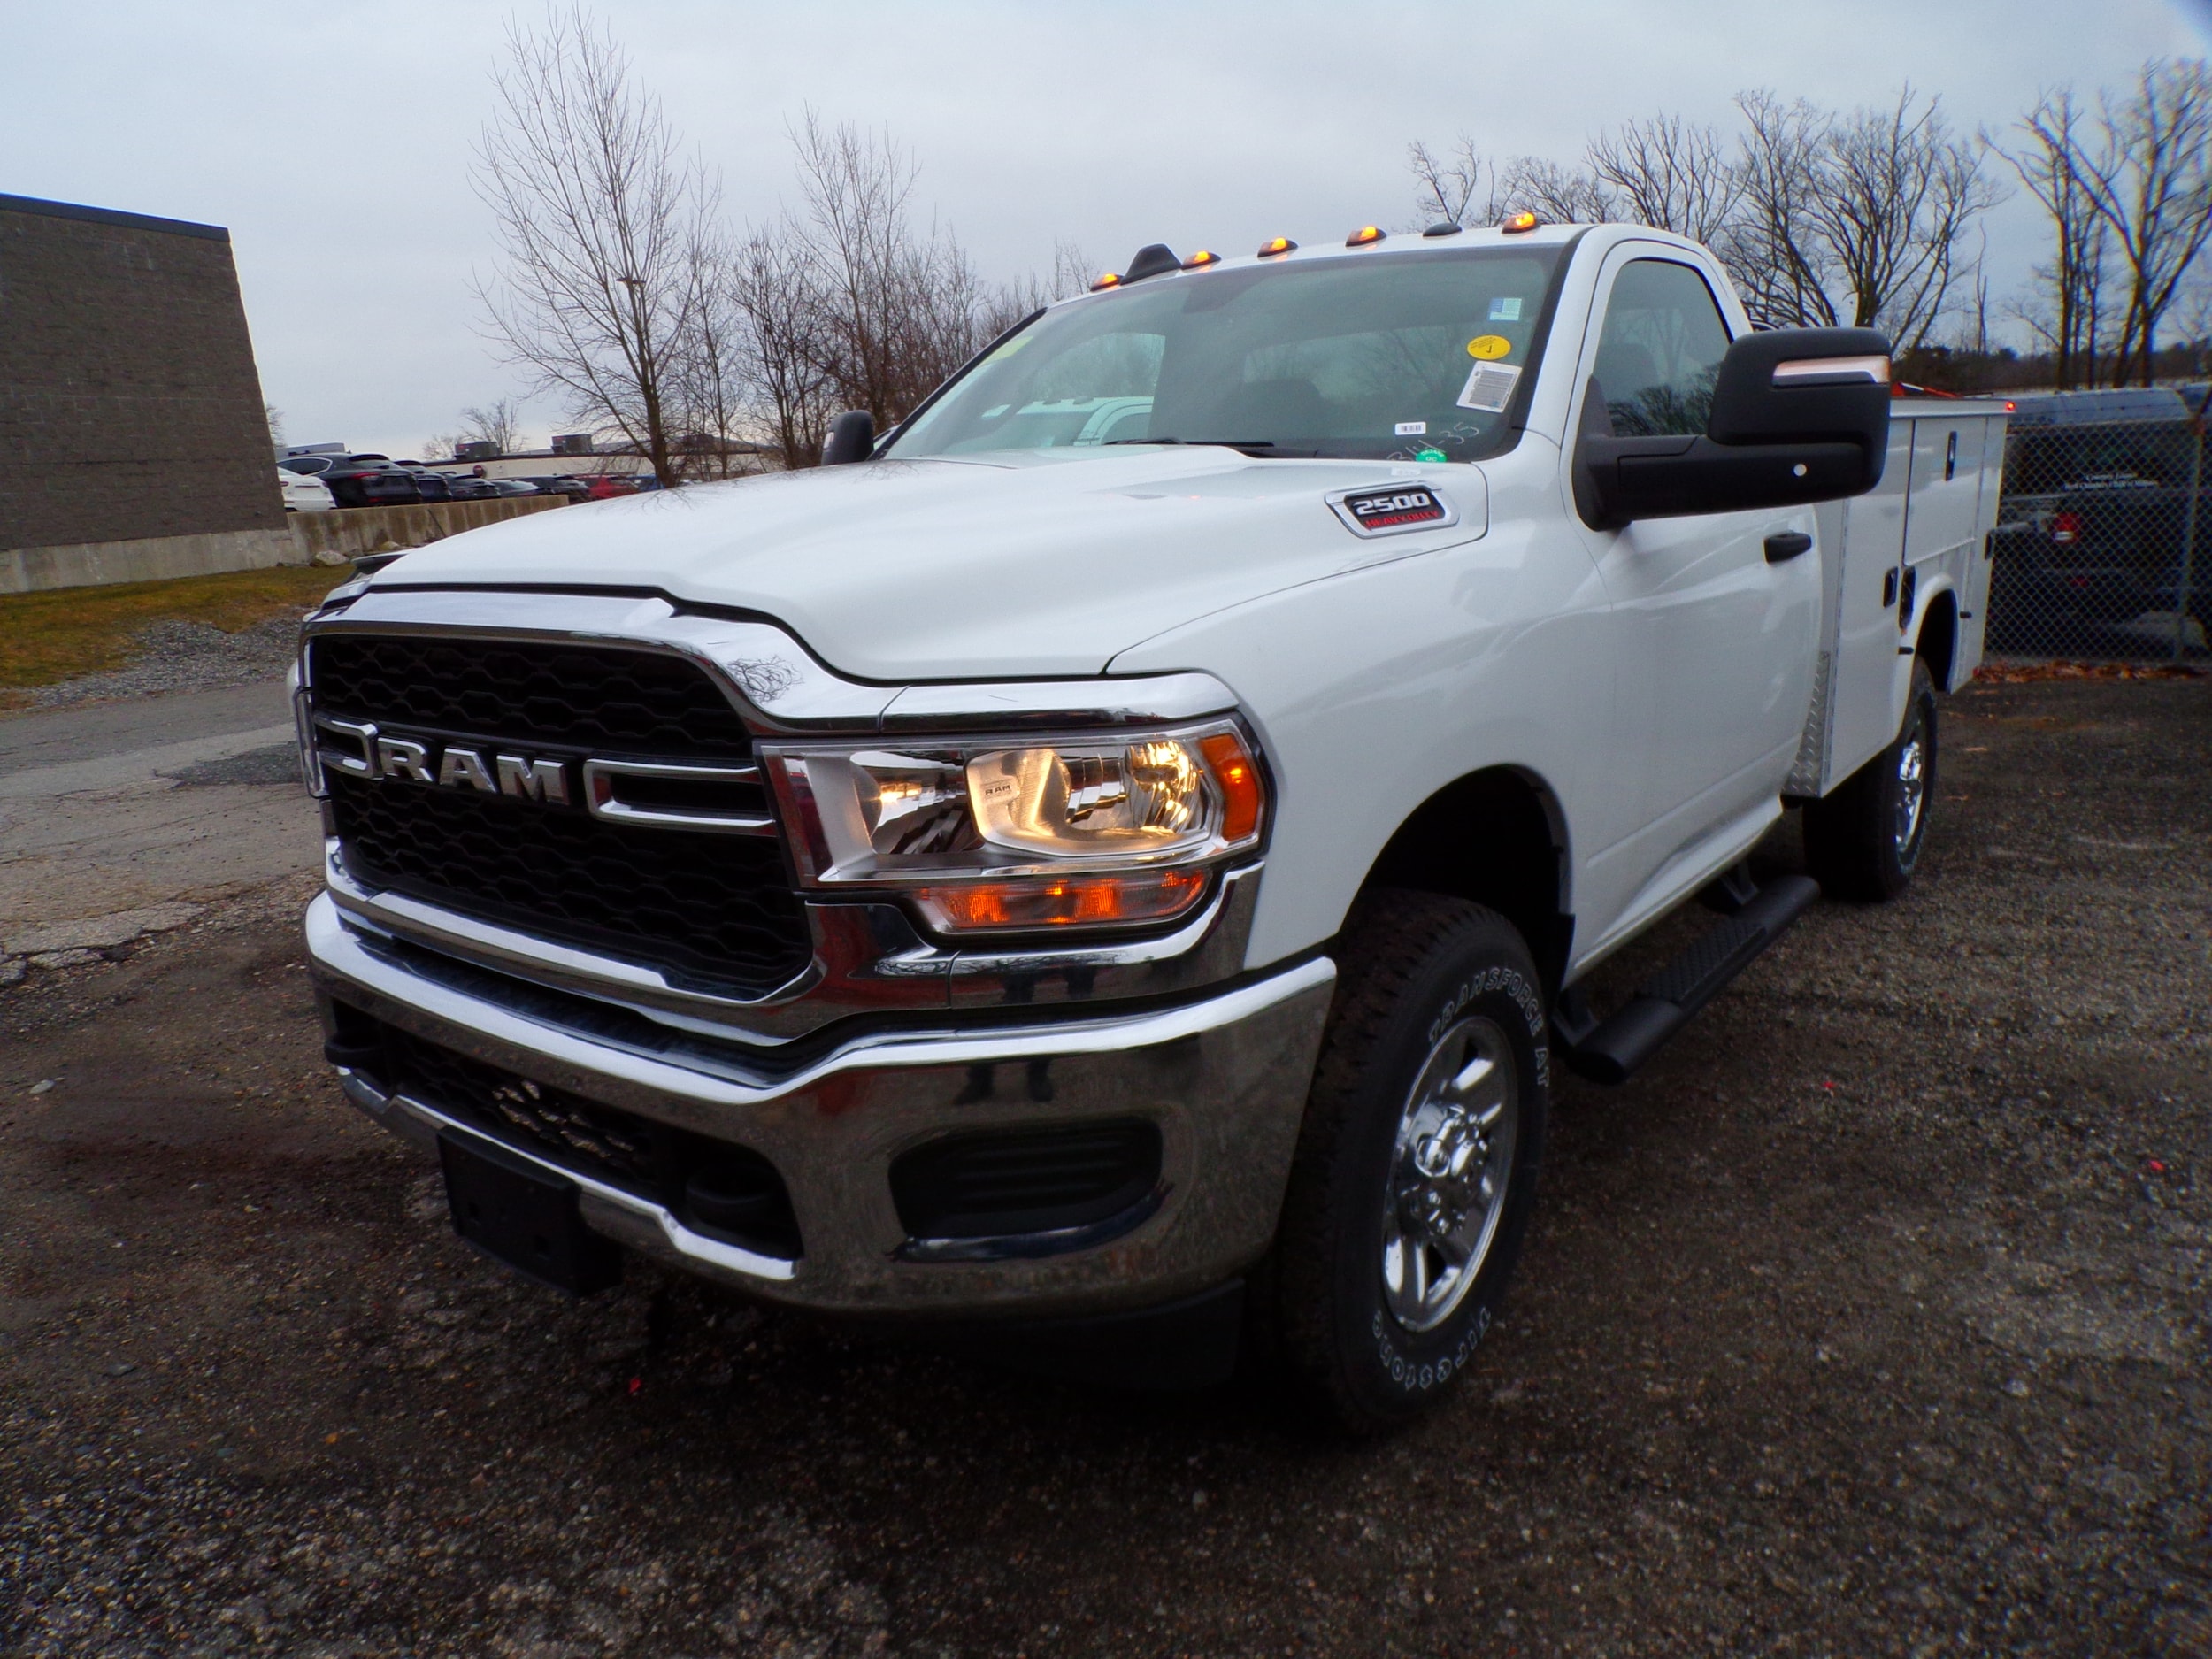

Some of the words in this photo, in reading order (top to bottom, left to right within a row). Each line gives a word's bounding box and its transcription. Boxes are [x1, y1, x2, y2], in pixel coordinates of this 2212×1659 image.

[1353, 493, 1431, 515] 2500
[377, 737, 570, 805] RAM
[985, 785, 1010, 795] RAM
[1429, 967, 1544, 1048] TRANSFORCE
[1535, 1048, 1549, 1087] AT
